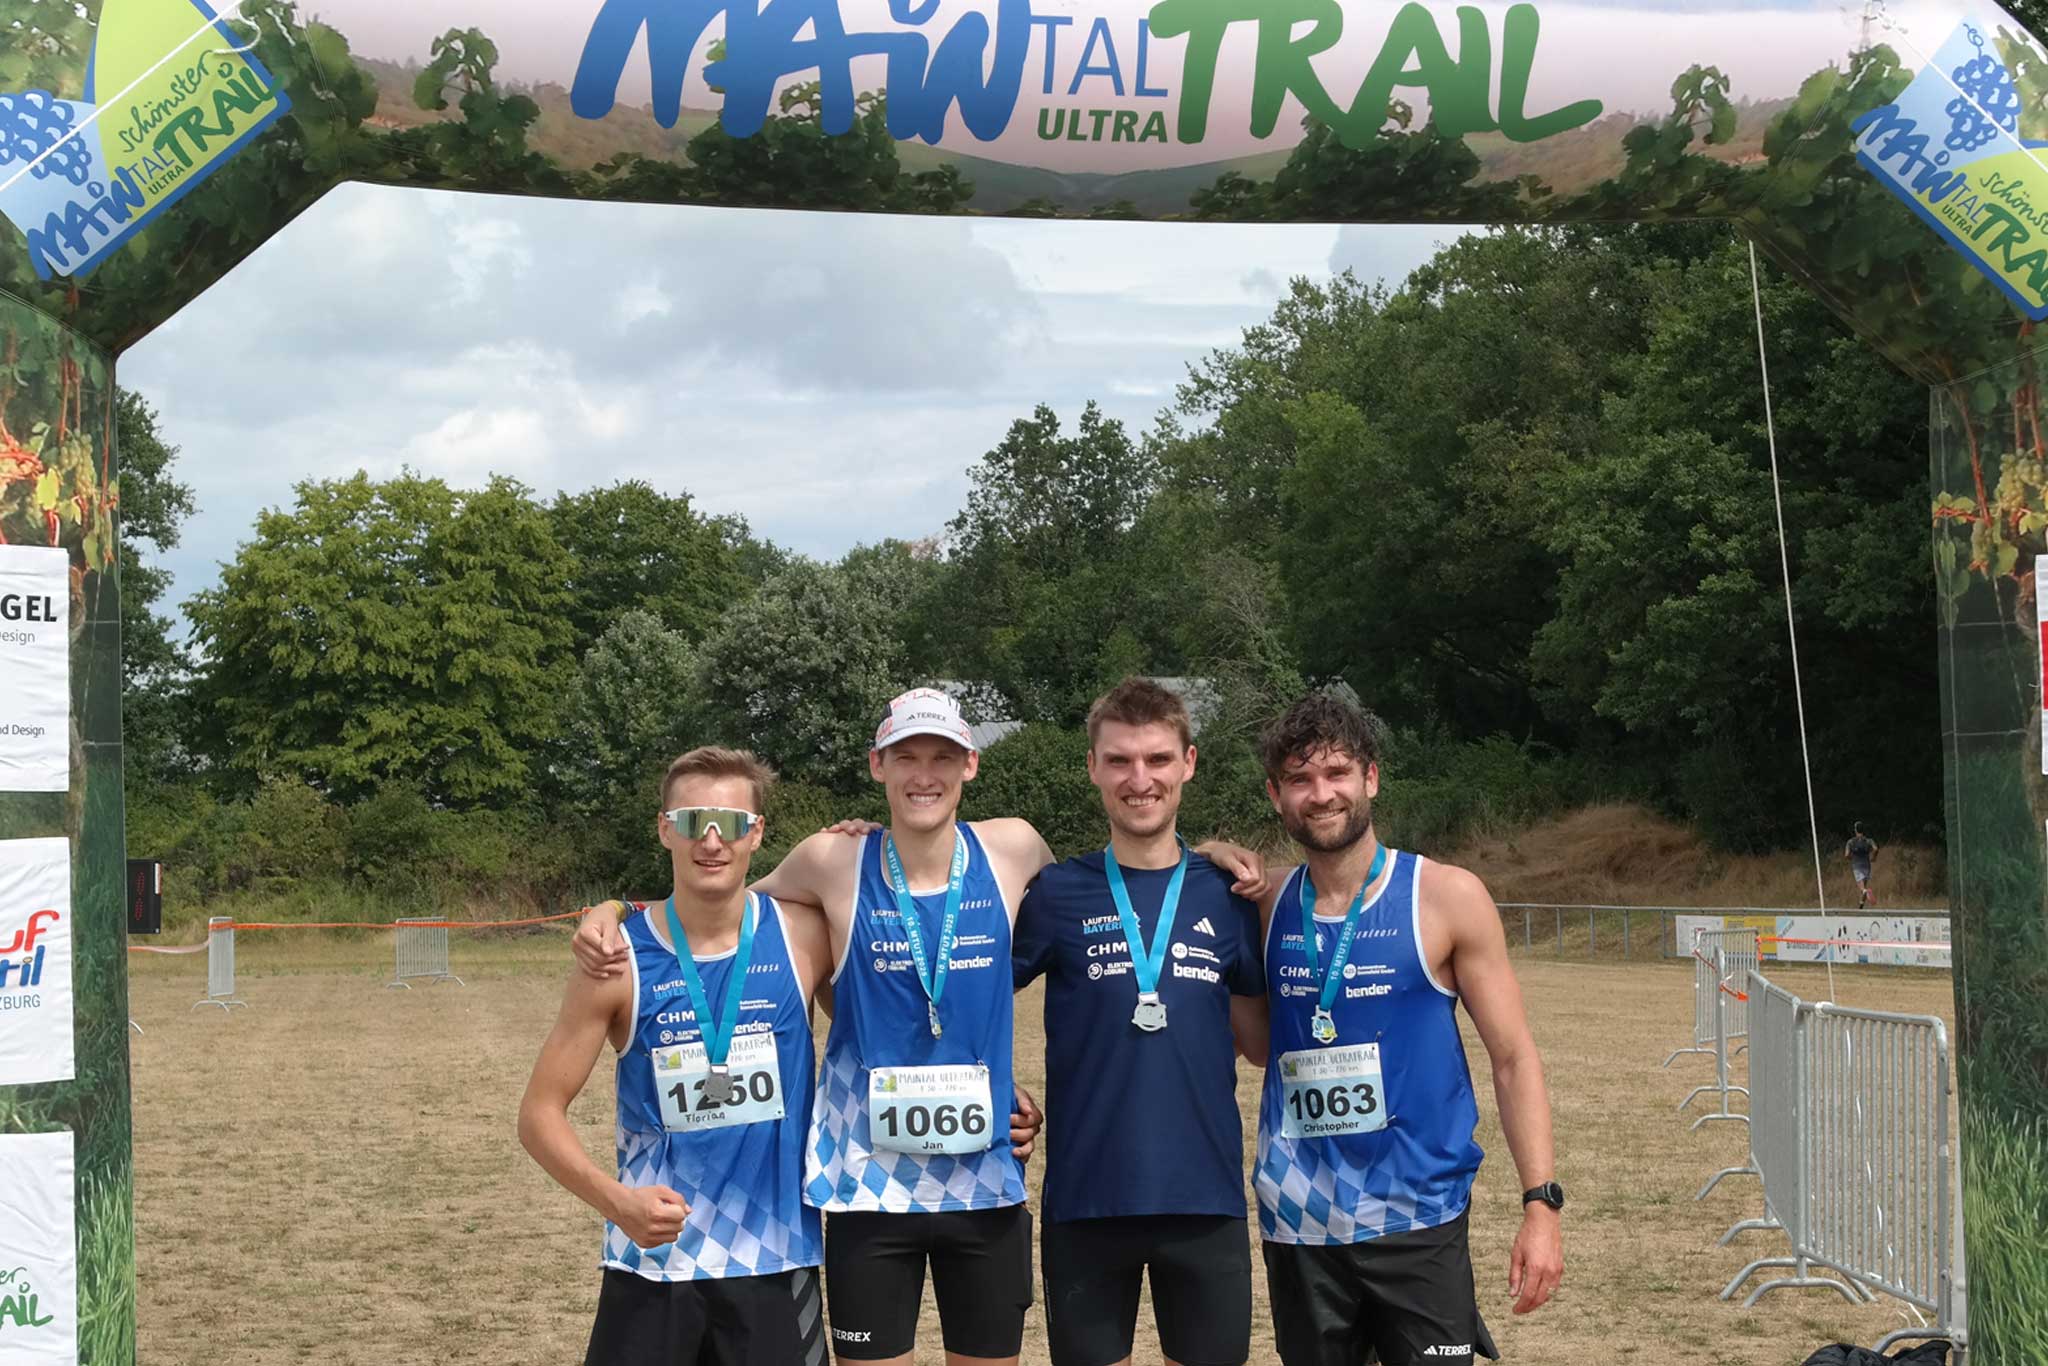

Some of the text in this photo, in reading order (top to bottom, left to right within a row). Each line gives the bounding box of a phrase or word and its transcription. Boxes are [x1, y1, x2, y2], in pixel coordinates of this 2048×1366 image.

[1028, 15, 1169, 98] TAL
[1036, 107, 1169, 144] ULTRA
[128, 148, 175, 186] TAL
[147, 164, 186, 196] ULTRA
[1952, 183, 1988, 225] TAL
[1942, 203, 1974, 236] ULTRA
[0, 593, 58, 622] GEL
[0, 628, 36, 646] esign
[12, 723, 45, 738] Design
[871, 941, 909, 952] CHM
[1087, 941, 1128, 957] CHM
[949, 955, 993, 970] bender
[1173, 962, 1220, 984] bender
[1345, 983, 1392, 998] bender
[656, 1010, 696, 1024] CHM
[732, 1019, 773, 1034] ender
[1289, 1083, 1378, 1121] 1063
[684, 1110, 726, 1123] Florian
[879, 1103, 986, 1137] 1066
[1304, 1120, 1360, 1133] Christopher
[922, 1140, 944, 1150] Jan
[833, 1327, 871, 1342] TERREX
